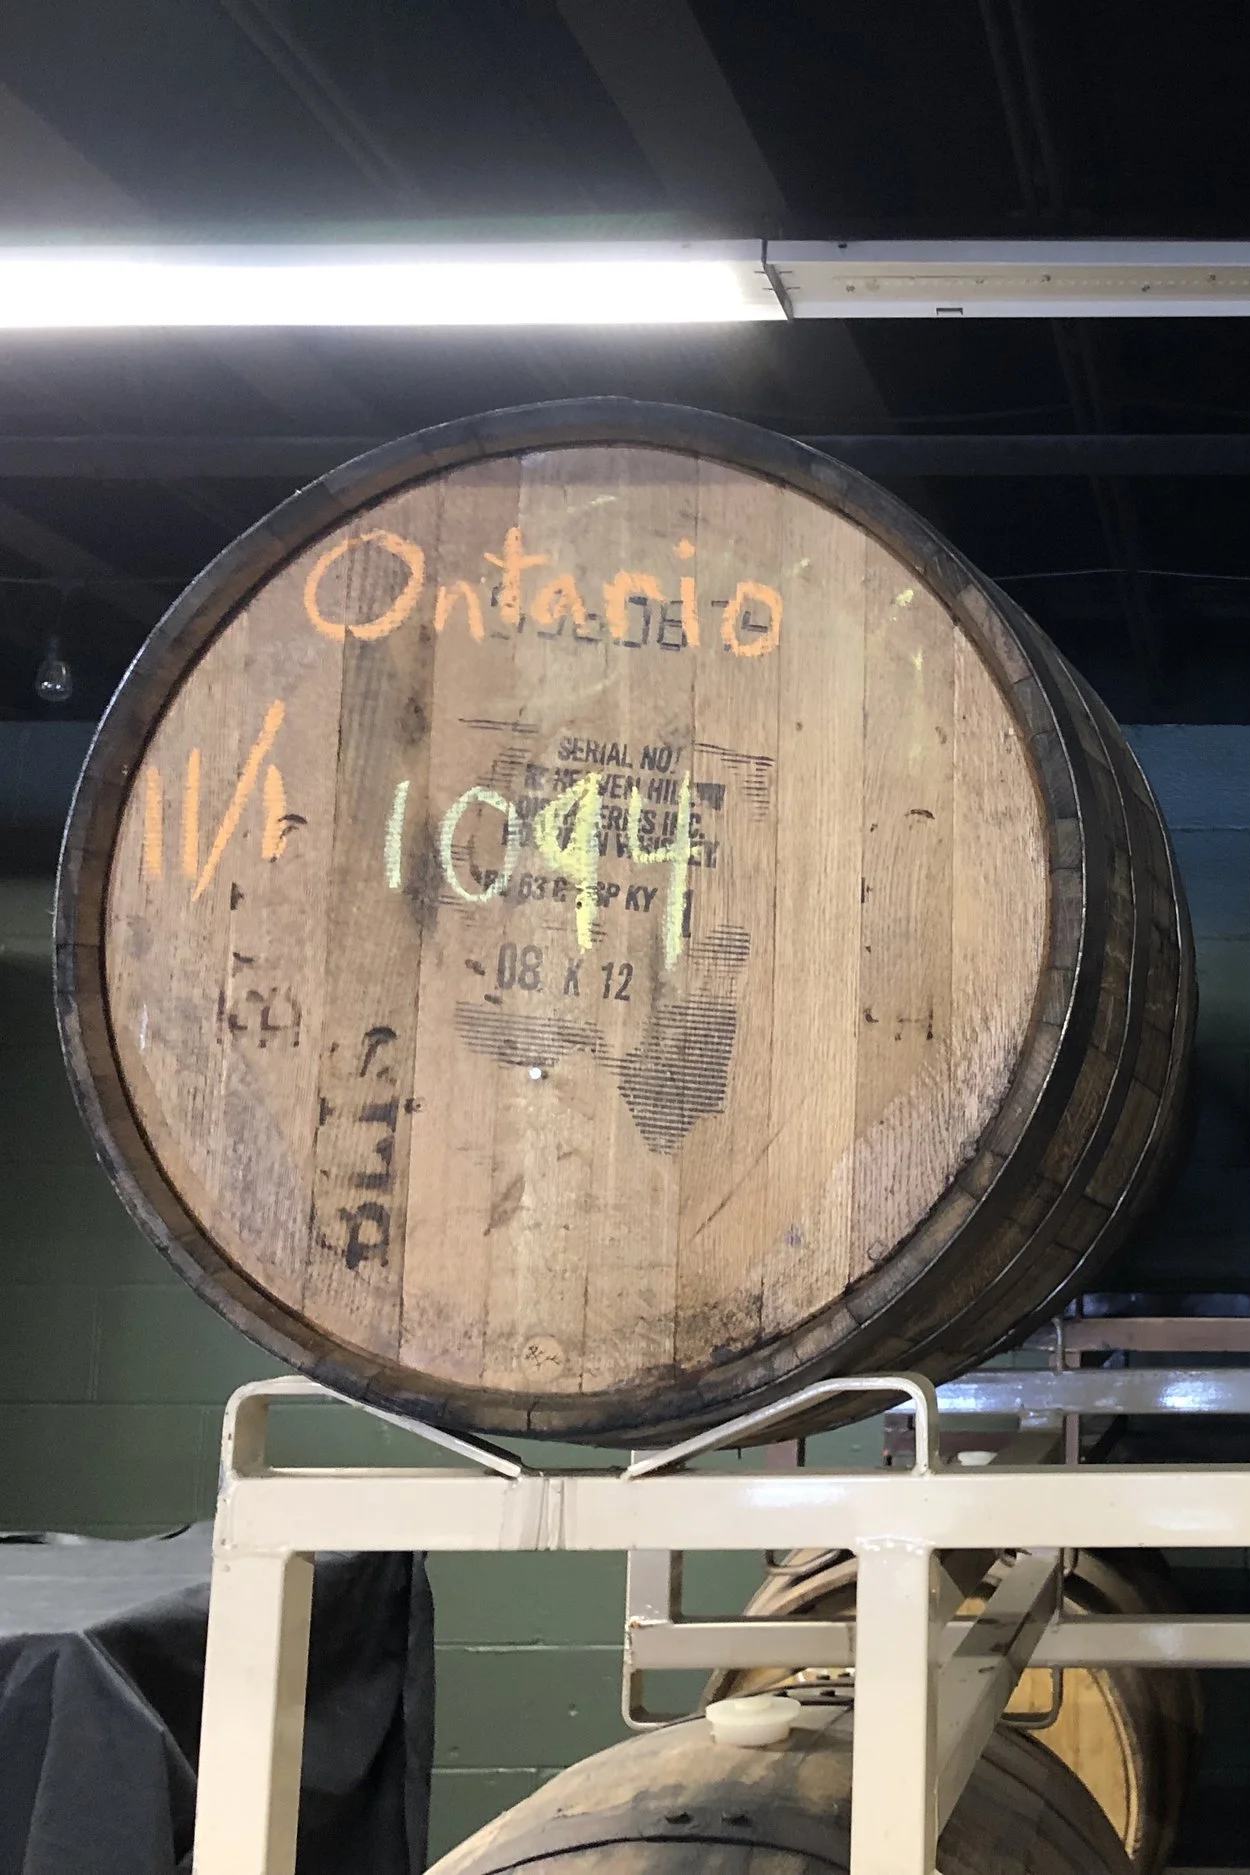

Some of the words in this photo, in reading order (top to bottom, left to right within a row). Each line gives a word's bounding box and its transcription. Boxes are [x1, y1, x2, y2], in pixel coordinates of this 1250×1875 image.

[304, 527, 783, 657] Ontario
[557, 736, 633, 769] SERIAL
[553, 767, 641, 801] HEVEN
[384, 770, 701, 970] 1094
[625, 884, 658, 912] KY
[498, 942, 543, 991] 08
[601, 962, 634, 1001] 12
